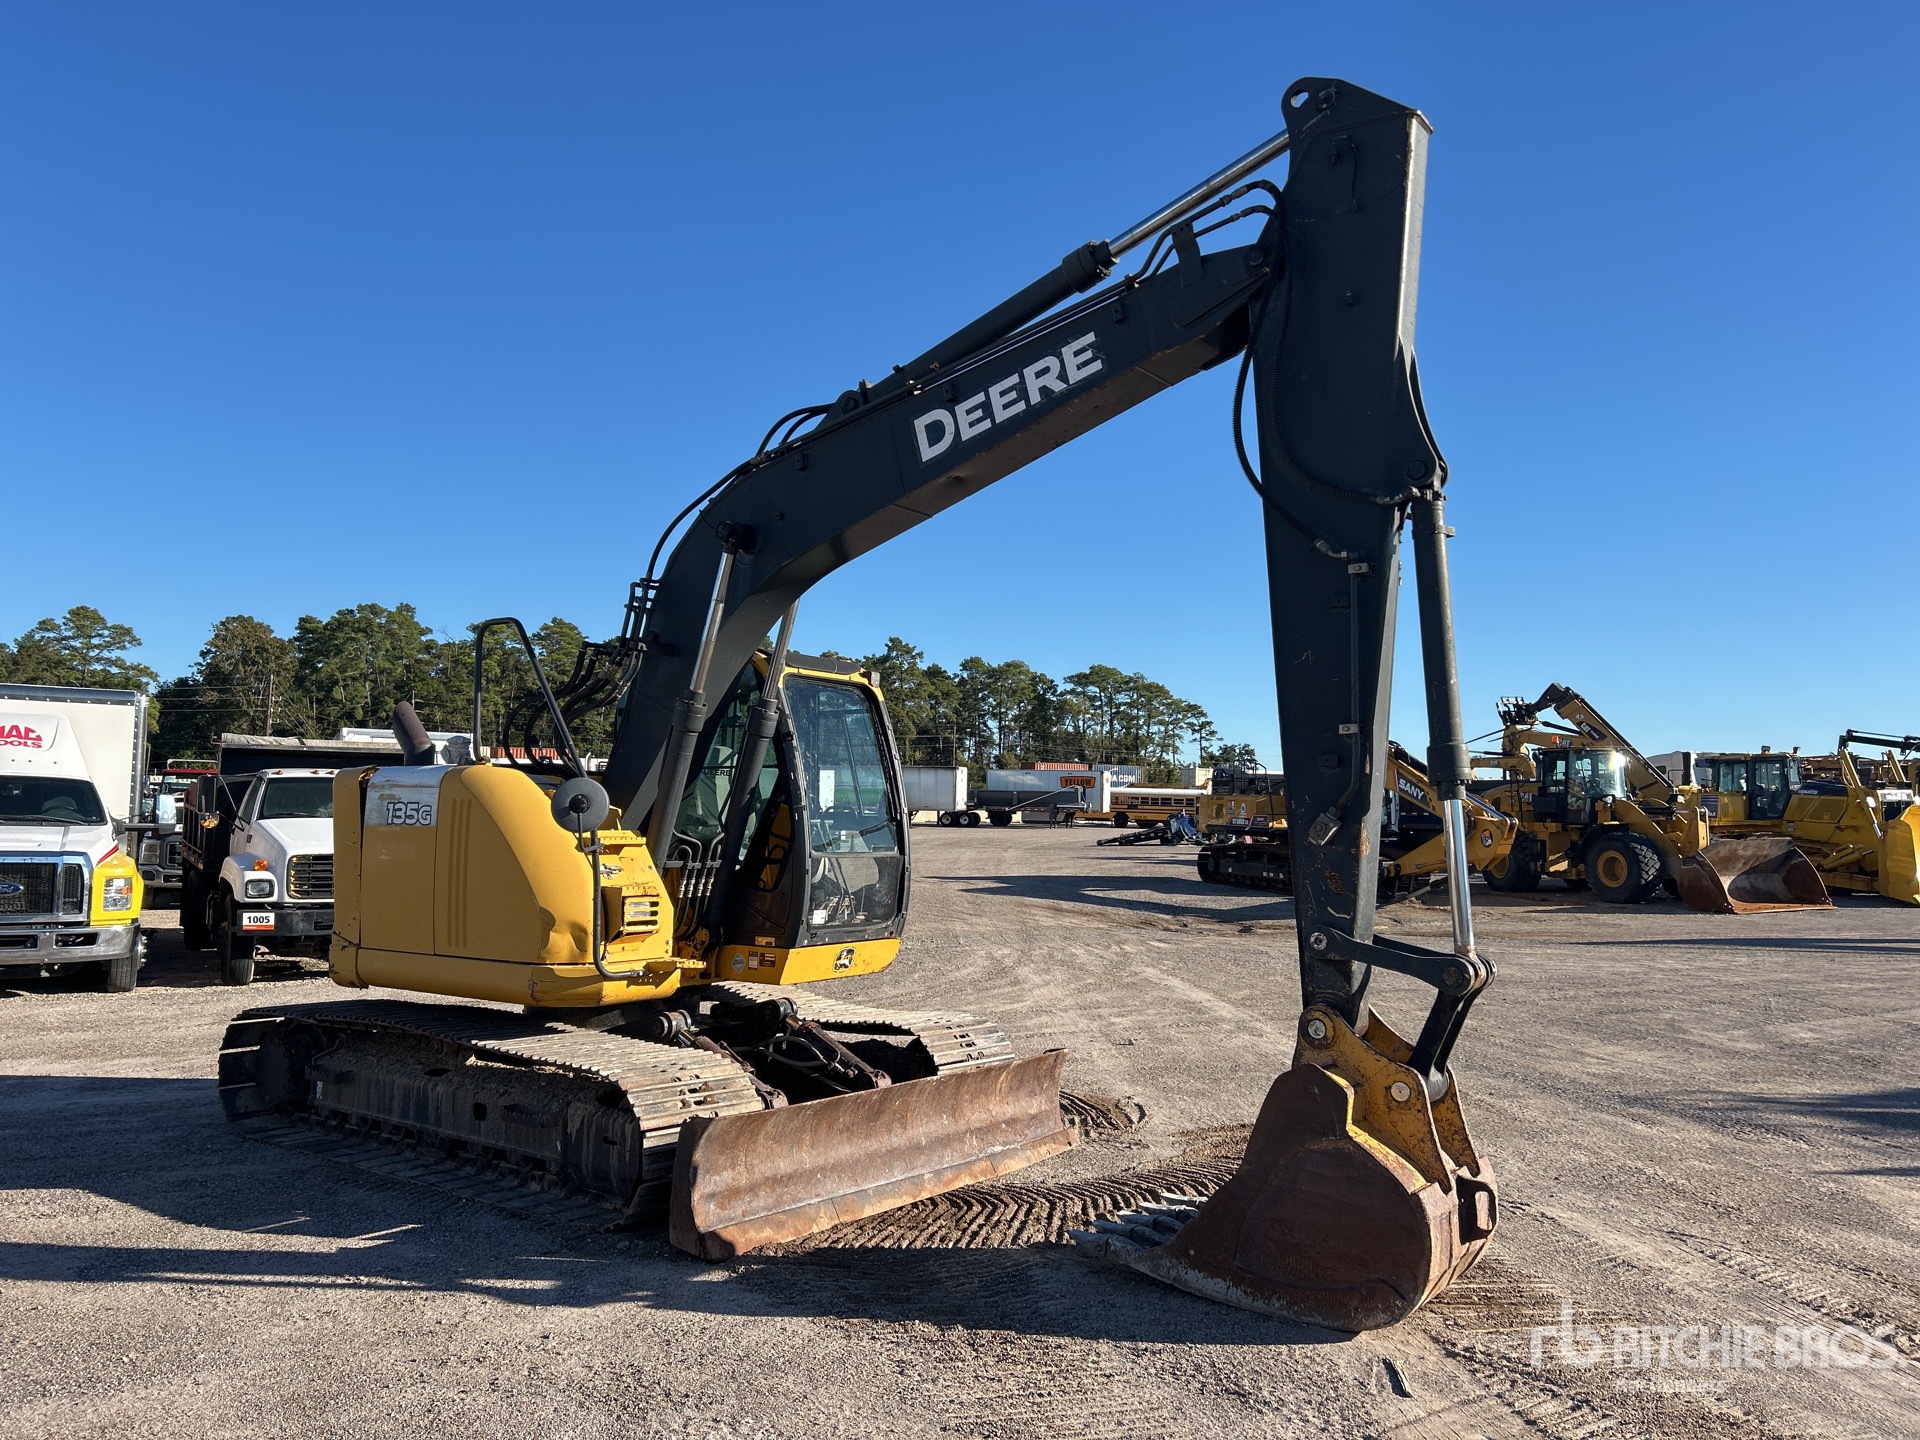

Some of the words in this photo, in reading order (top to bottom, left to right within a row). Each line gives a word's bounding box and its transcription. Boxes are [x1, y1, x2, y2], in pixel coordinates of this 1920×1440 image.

[914, 331, 1103, 462] DEERE
[0, 740, 43, 749] OOLS
[1064, 778, 1092, 787] YELLOW
[1398, 778, 1425, 800] SANY
[387, 801, 433, 826] 135G
[247, 915, 271, 924] 1005
